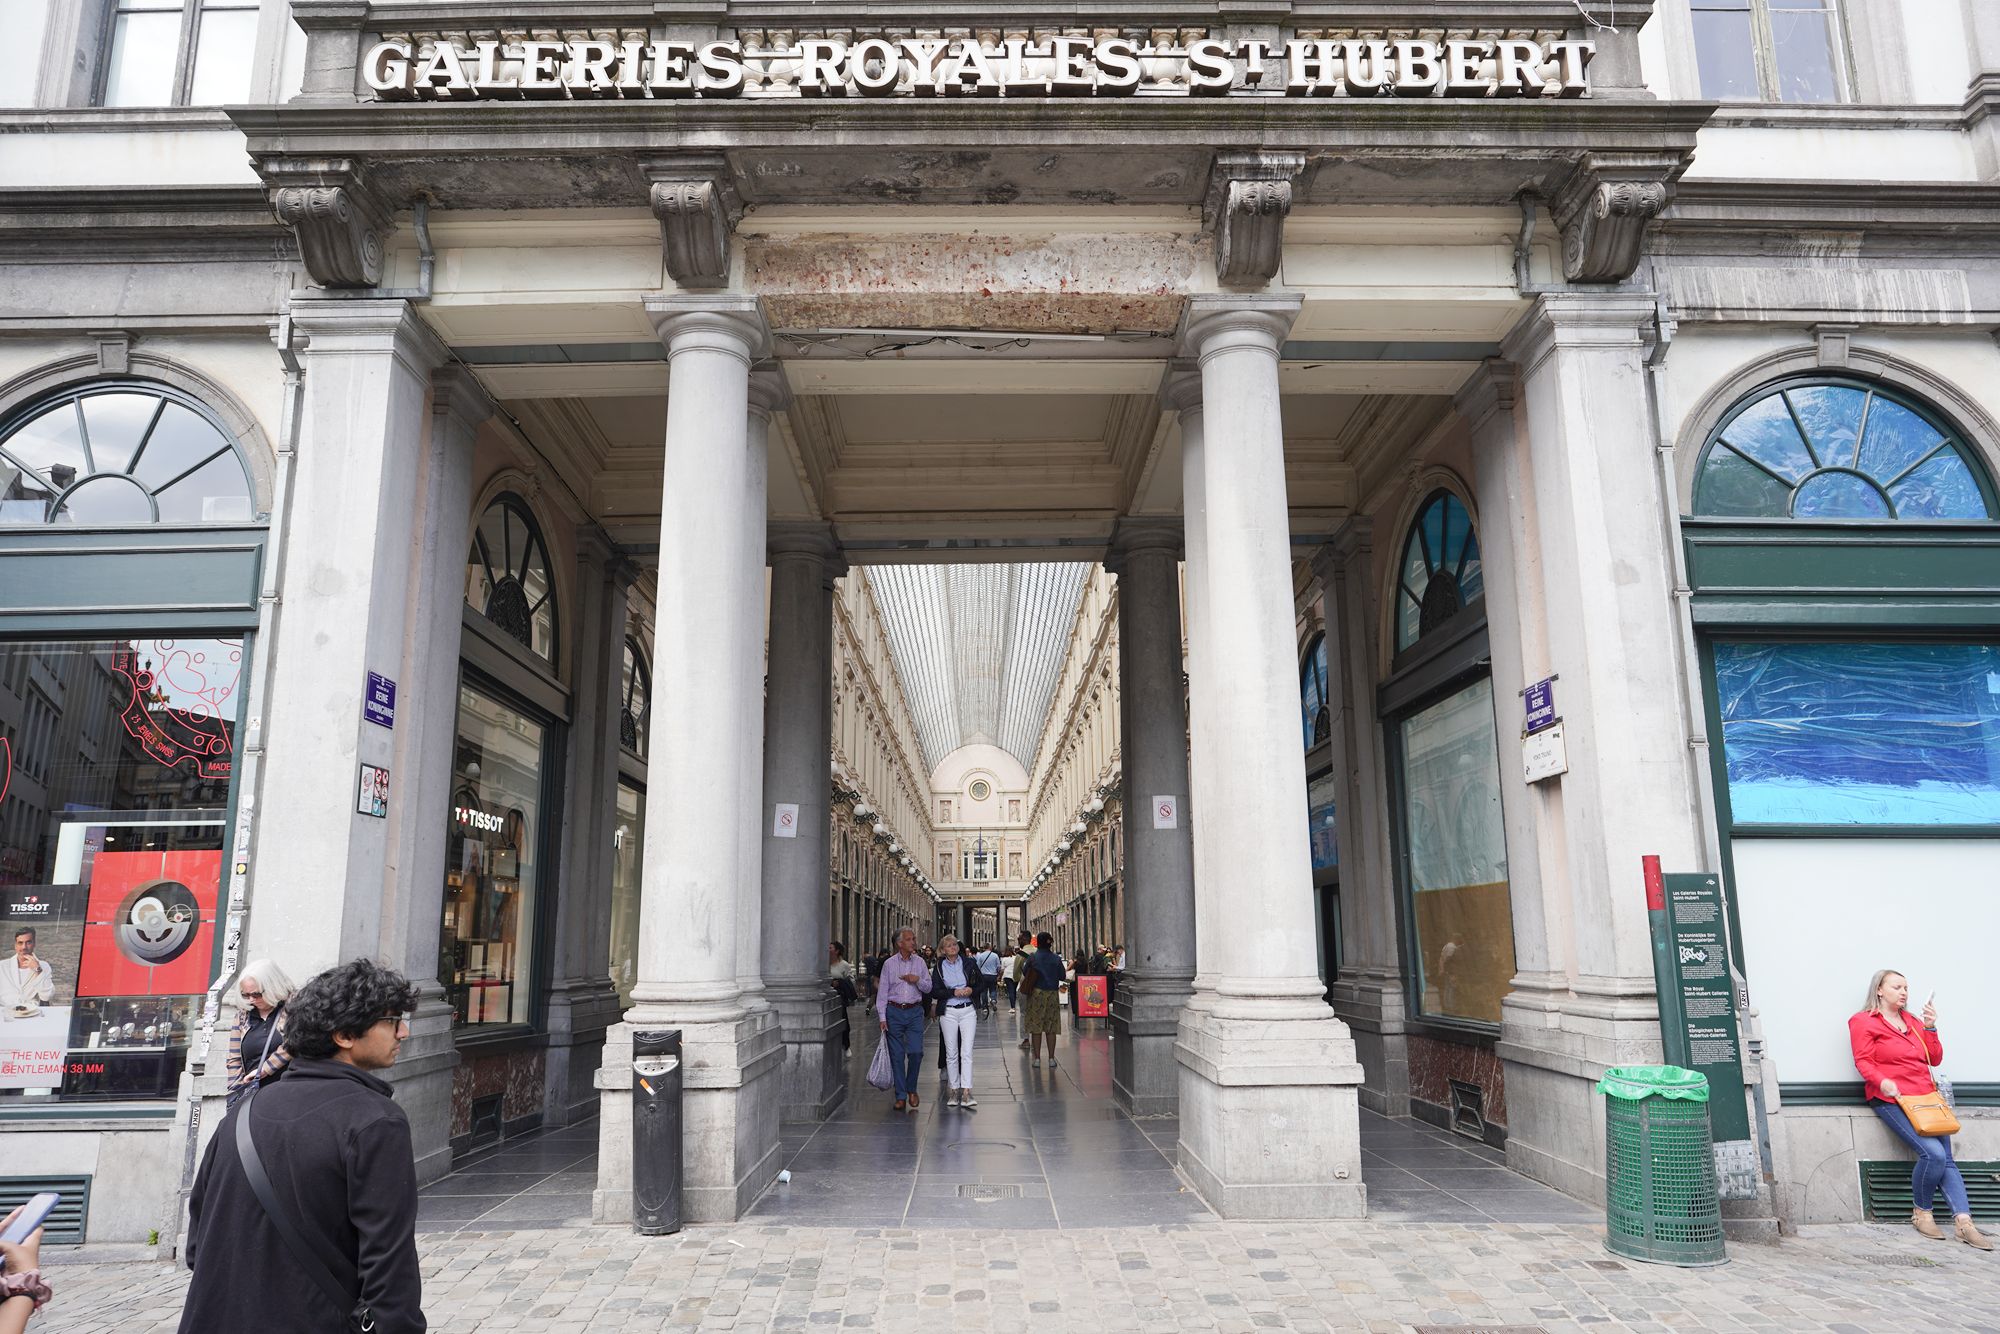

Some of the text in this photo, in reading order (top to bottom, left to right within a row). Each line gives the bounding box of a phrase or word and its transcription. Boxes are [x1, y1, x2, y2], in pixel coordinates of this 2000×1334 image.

[363, 38, 744, 99] GALERIES
[799, 37, 1140, 98] ROYALES
[1285, 38, 1596, 98] HUBERT
[138, 726, 157, 745] JEWELS
[155, 741, 175, 758] SWISS
[207, 762, 232, 771] MADE
[468, 809, 504, 833] TISSOT
[10, 903, 50, 912] TISSOT
[11, 1051, 32, 1061] THE
[34, 1050, 60, 1061] NEW
[2, 1063, 105, 1075] GENTLEMAN 38 MM
